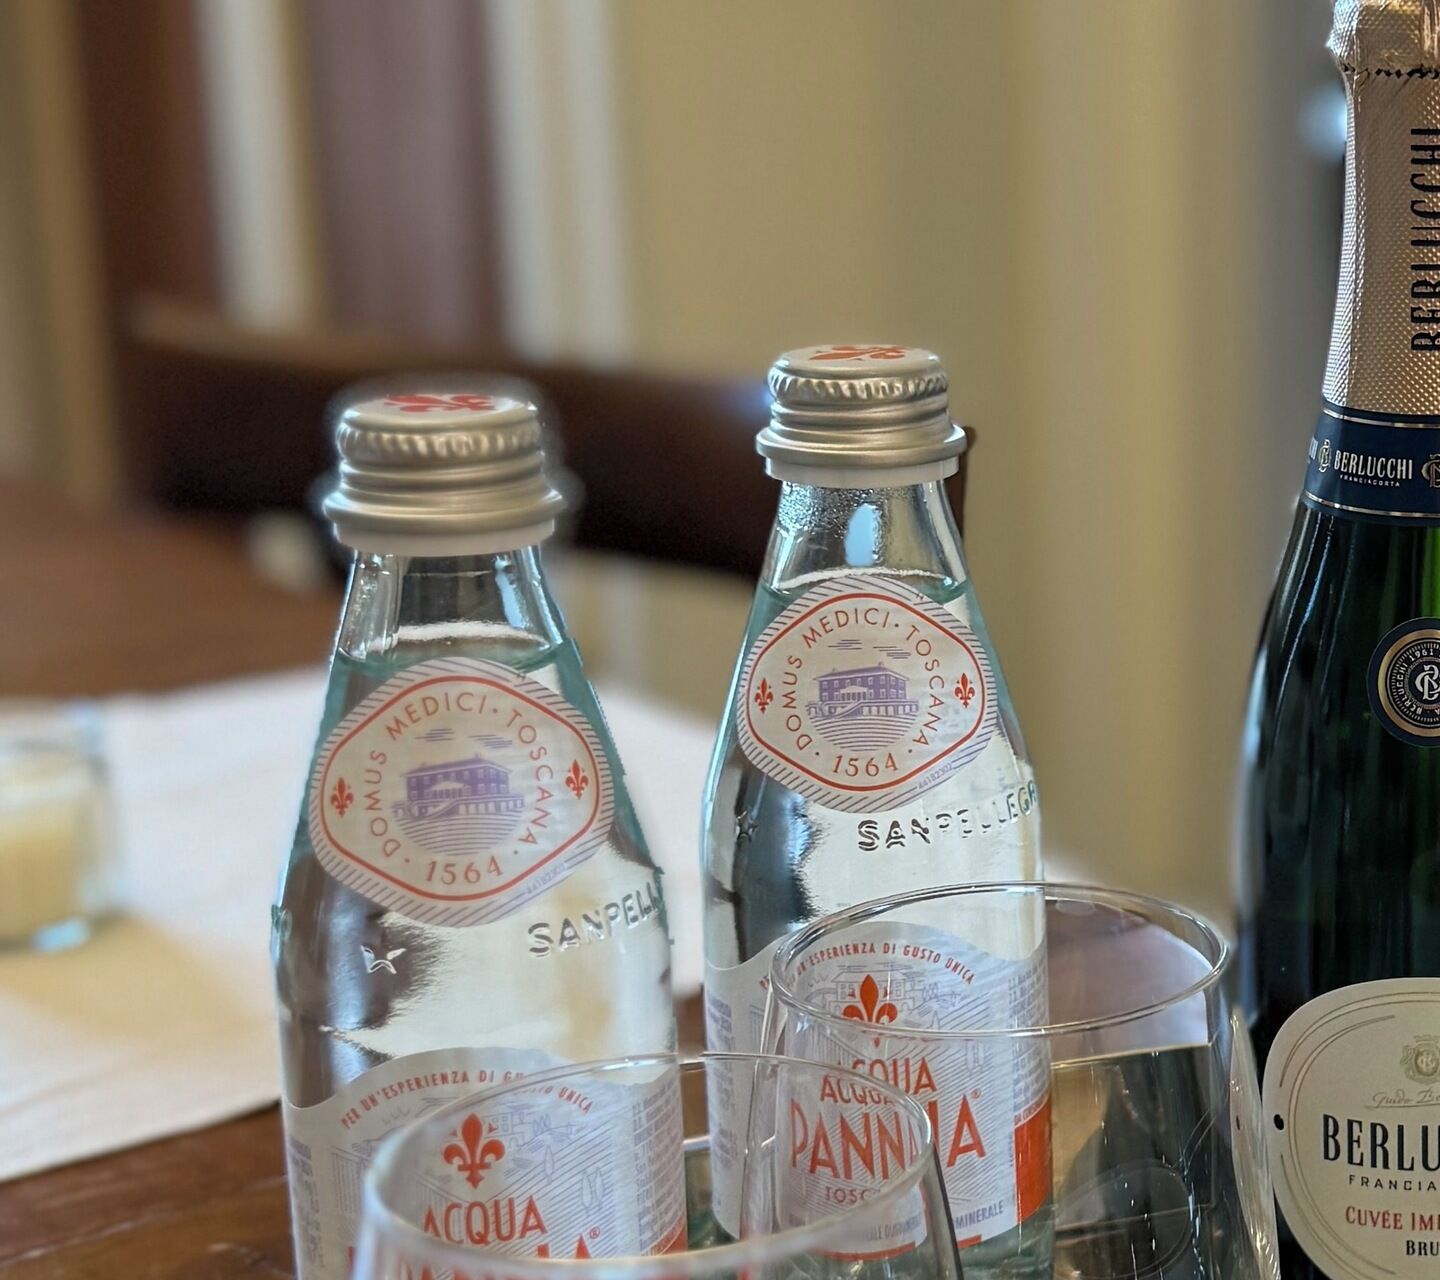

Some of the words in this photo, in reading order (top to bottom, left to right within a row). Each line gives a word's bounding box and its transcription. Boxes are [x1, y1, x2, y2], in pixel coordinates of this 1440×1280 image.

[1334, 451, 1413, 480] BERLUCCHI
[1339, 474, 1400, 487] FRANCIACORTA
[1409, 649, 1434, 661] 1961
[781, 655, 813, 751] DOMUS
[802, 607, 890, 649] MEDICI
[906, 625, 945, 747] TOSCANA
[1397, 662, 1422, 715] BERLUCCHI
[362, 748, 401, 858] DOMUS
[386, 691, 488, 741] MEDICI
[506, 708, 554, 847] TOSCANA
[833, 752, 898, 777] 1564
[426, 855, 504, 886] 1564
[883, 942, 896, 955] DI
[903, 944, 942, 964] GUSTO
[945, 956, 976, 985] UNICA
[340, 1110, 362, 1131] PER
[360, 1071, 470, 1112] UN'ESPERIENZA
[479, 1070, 495, 1084] DI
[558, 1087, 595, 1115] UNICA
[424, 1194, 548, 1246] ACQUA
